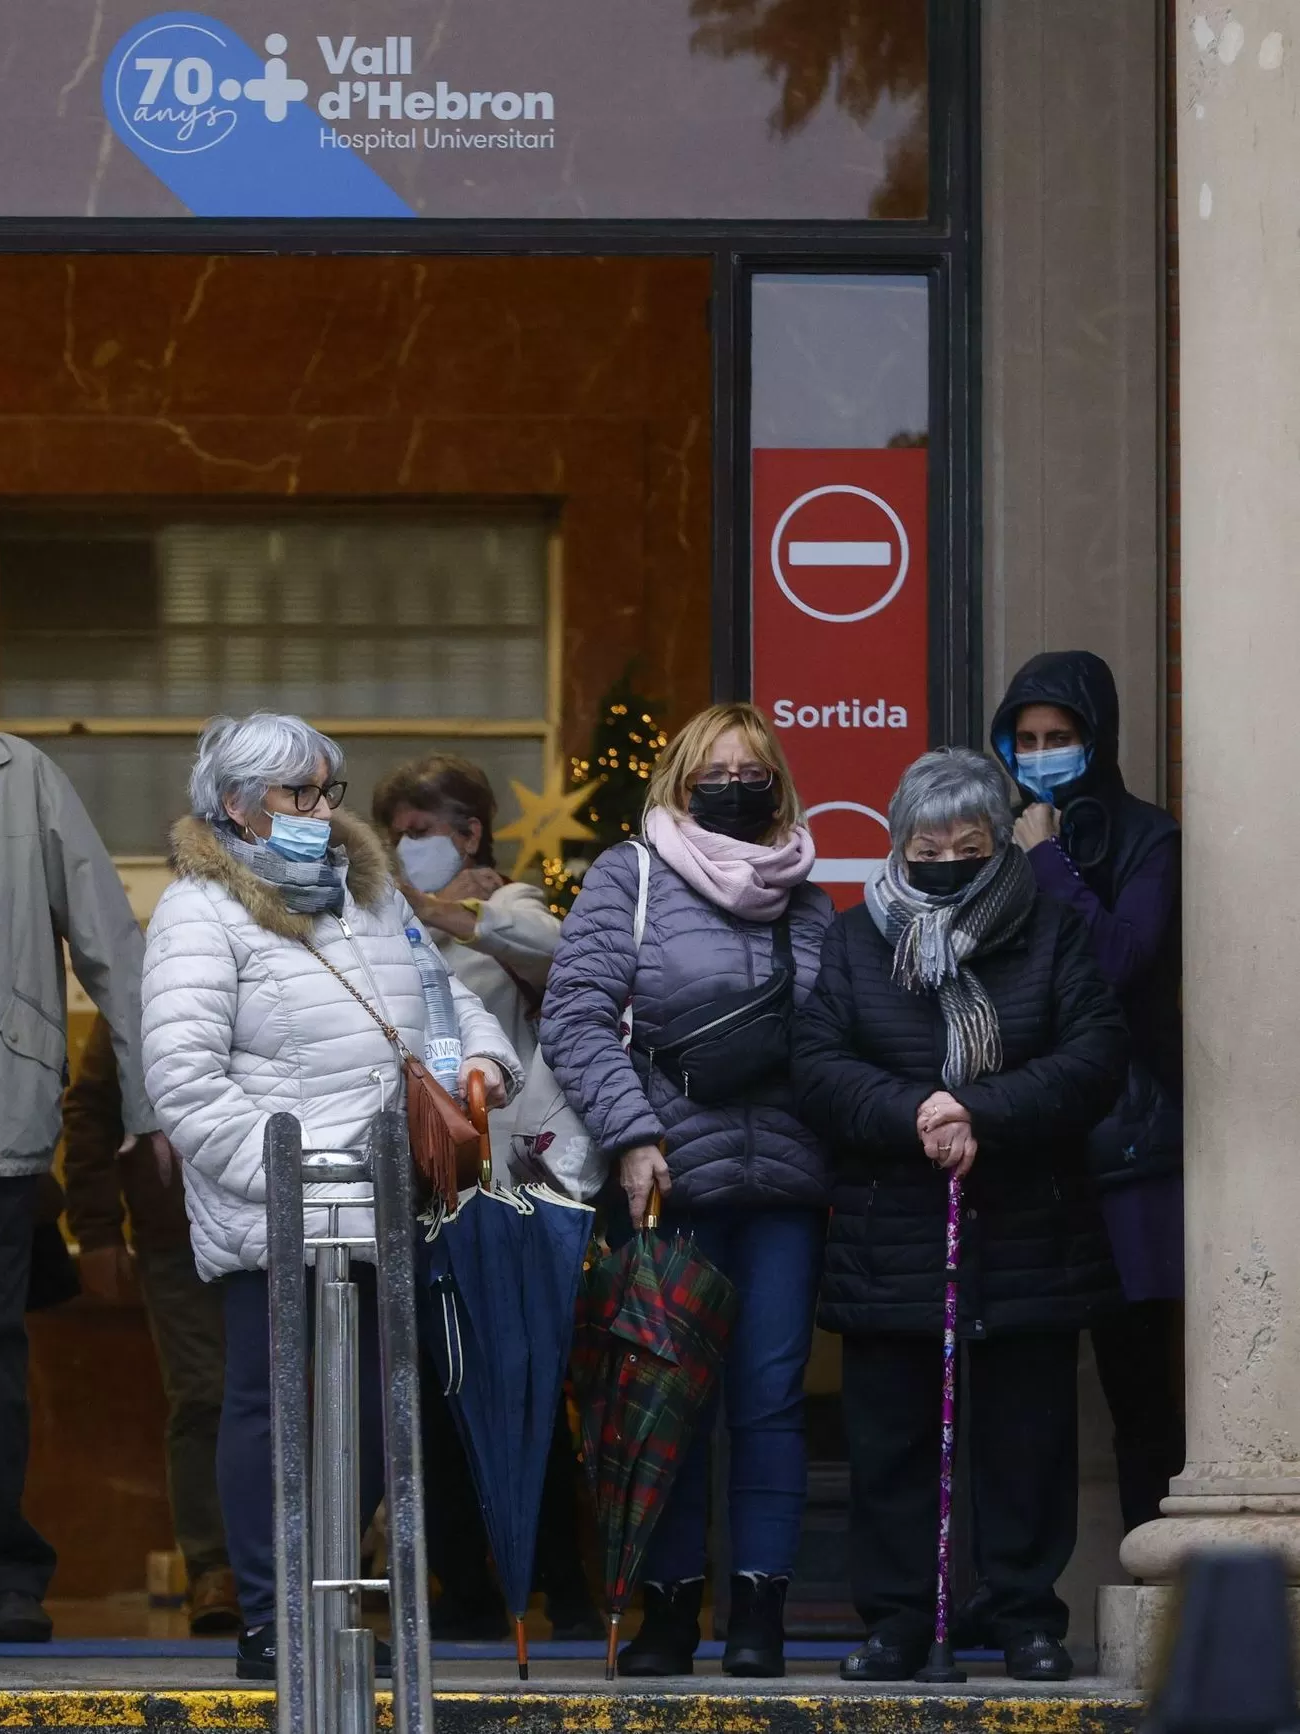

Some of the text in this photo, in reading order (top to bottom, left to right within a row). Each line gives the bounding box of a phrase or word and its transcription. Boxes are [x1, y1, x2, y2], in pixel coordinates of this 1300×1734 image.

[317, 36, 412, 75] Vall
[135, 57, 213, 105] 70
[318, 81, 554, 120] d'Hebron
[134, 102, 226, 141] anys
[320, 128, 555, 154] Hospital Universitari
[773, 699, 908, 729] Sortida
